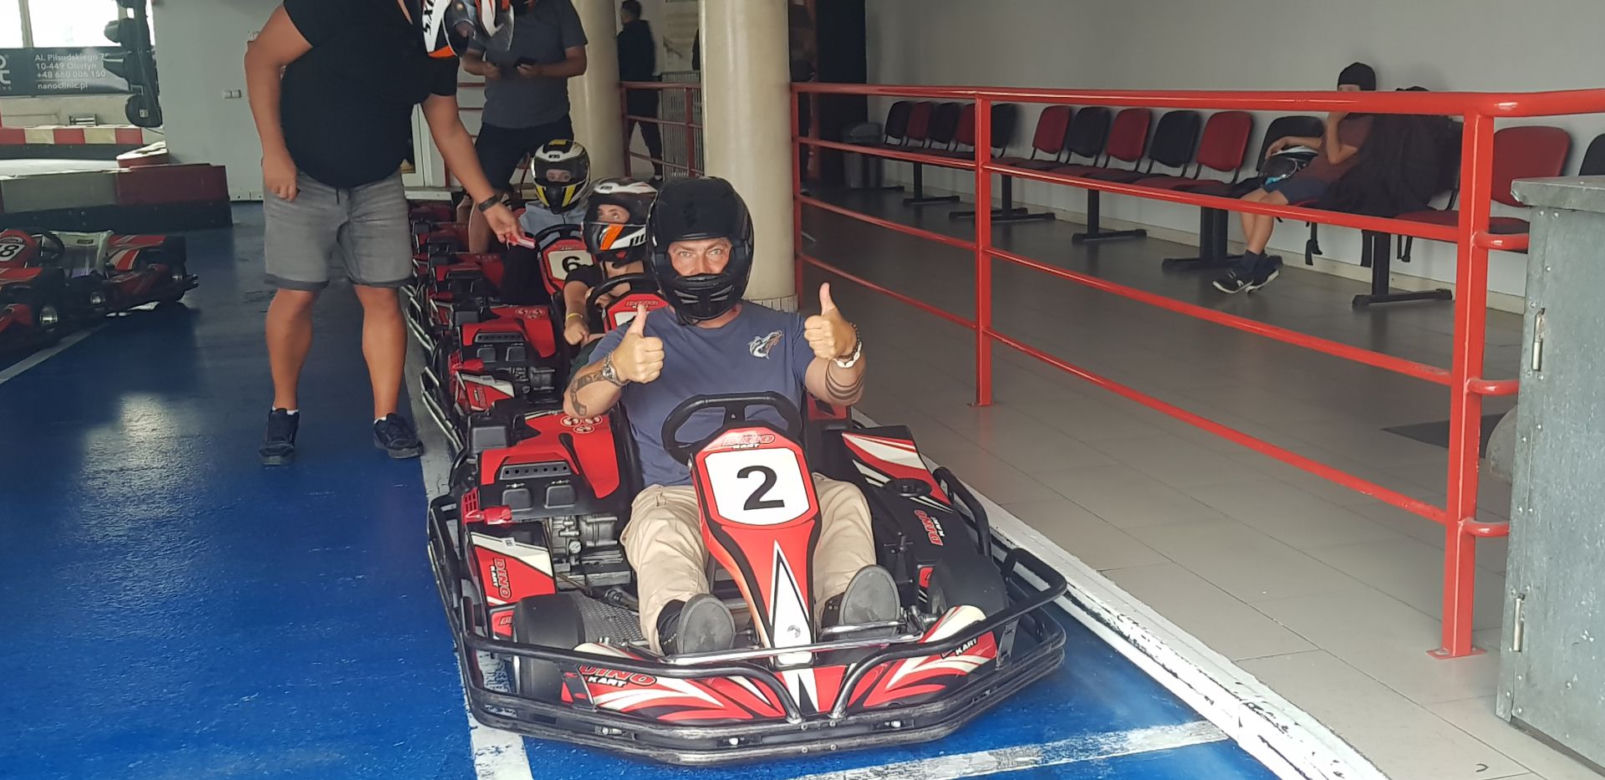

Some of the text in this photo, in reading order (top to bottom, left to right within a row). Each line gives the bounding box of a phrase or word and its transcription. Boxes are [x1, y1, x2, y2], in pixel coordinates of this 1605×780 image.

[36, 62, 64, 70] 10-449
[37, 81, 88, 90] nanoclinic.pl
[562, 256, 581, 273] 6
[736, 465, 785, 511] 2
[494, 558, 511, 599] DINO
[955, 638, 977, 656] KART
[587, 676, 627, 688] KART
